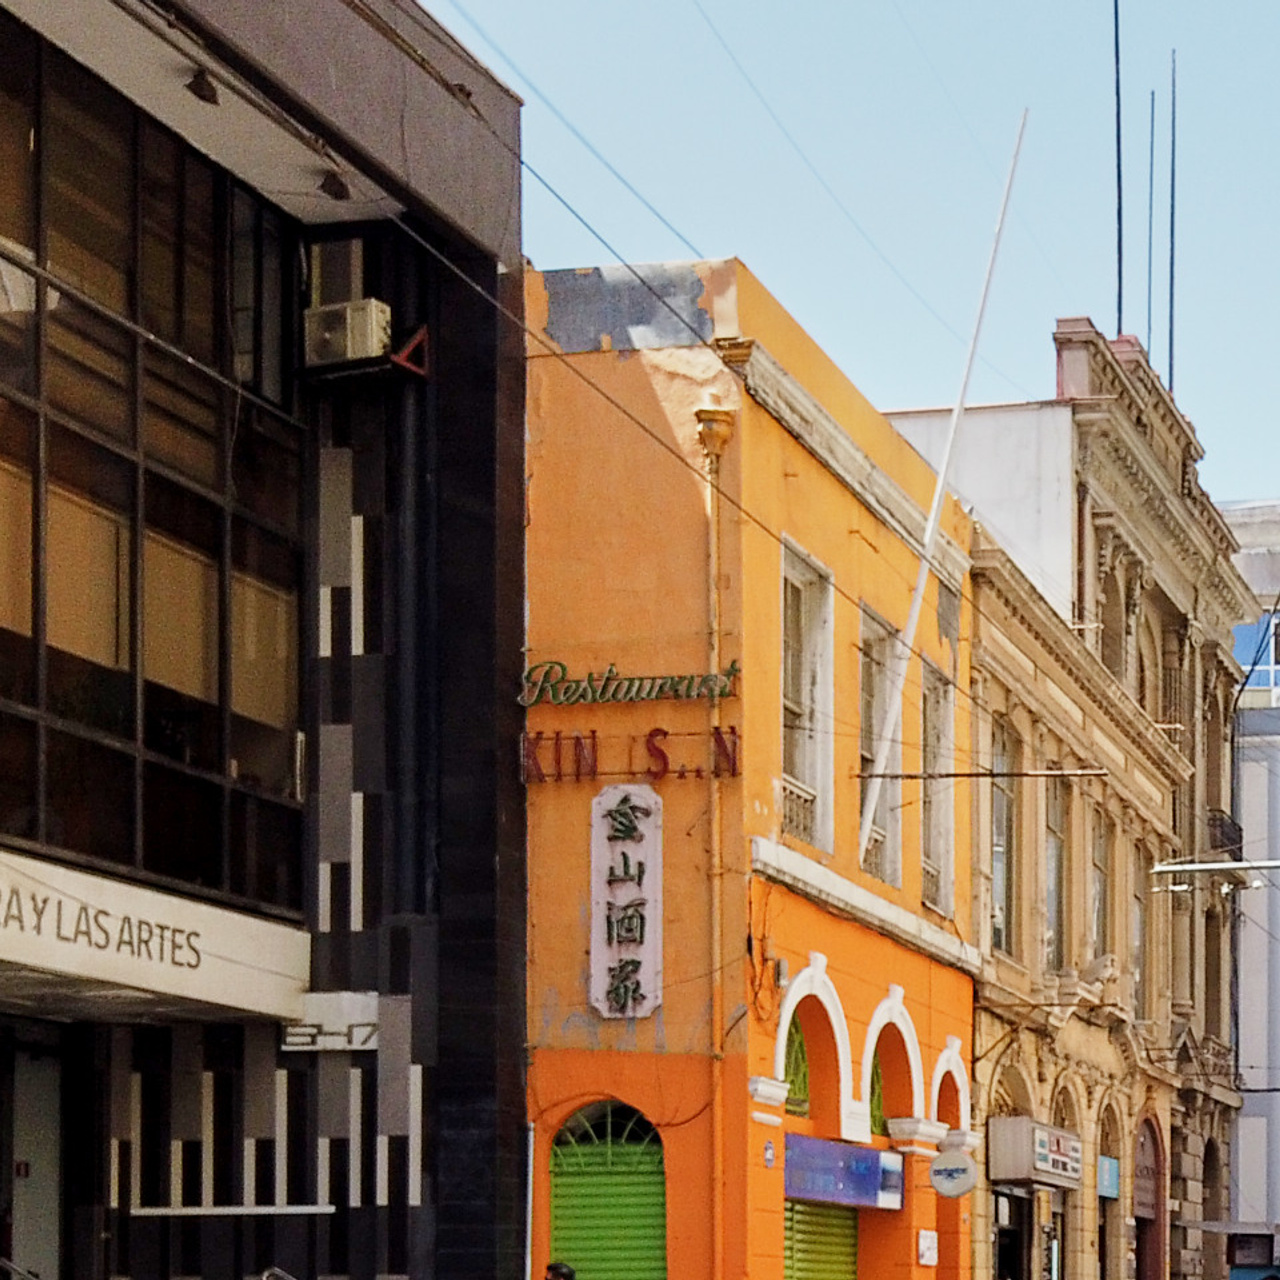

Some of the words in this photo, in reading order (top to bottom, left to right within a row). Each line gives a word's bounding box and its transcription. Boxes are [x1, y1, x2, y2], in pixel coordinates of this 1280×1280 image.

[517, 660, 741, 707] Restaurant
[521, 729, 597, 783] KIN
[646, 725, 738, 782] SN
[0, 887, 25, 934] A
[31, 892, 50, 937] Y
[56, 898, 112, 951] LAS
[116, 915, 202, 970] ARTES
